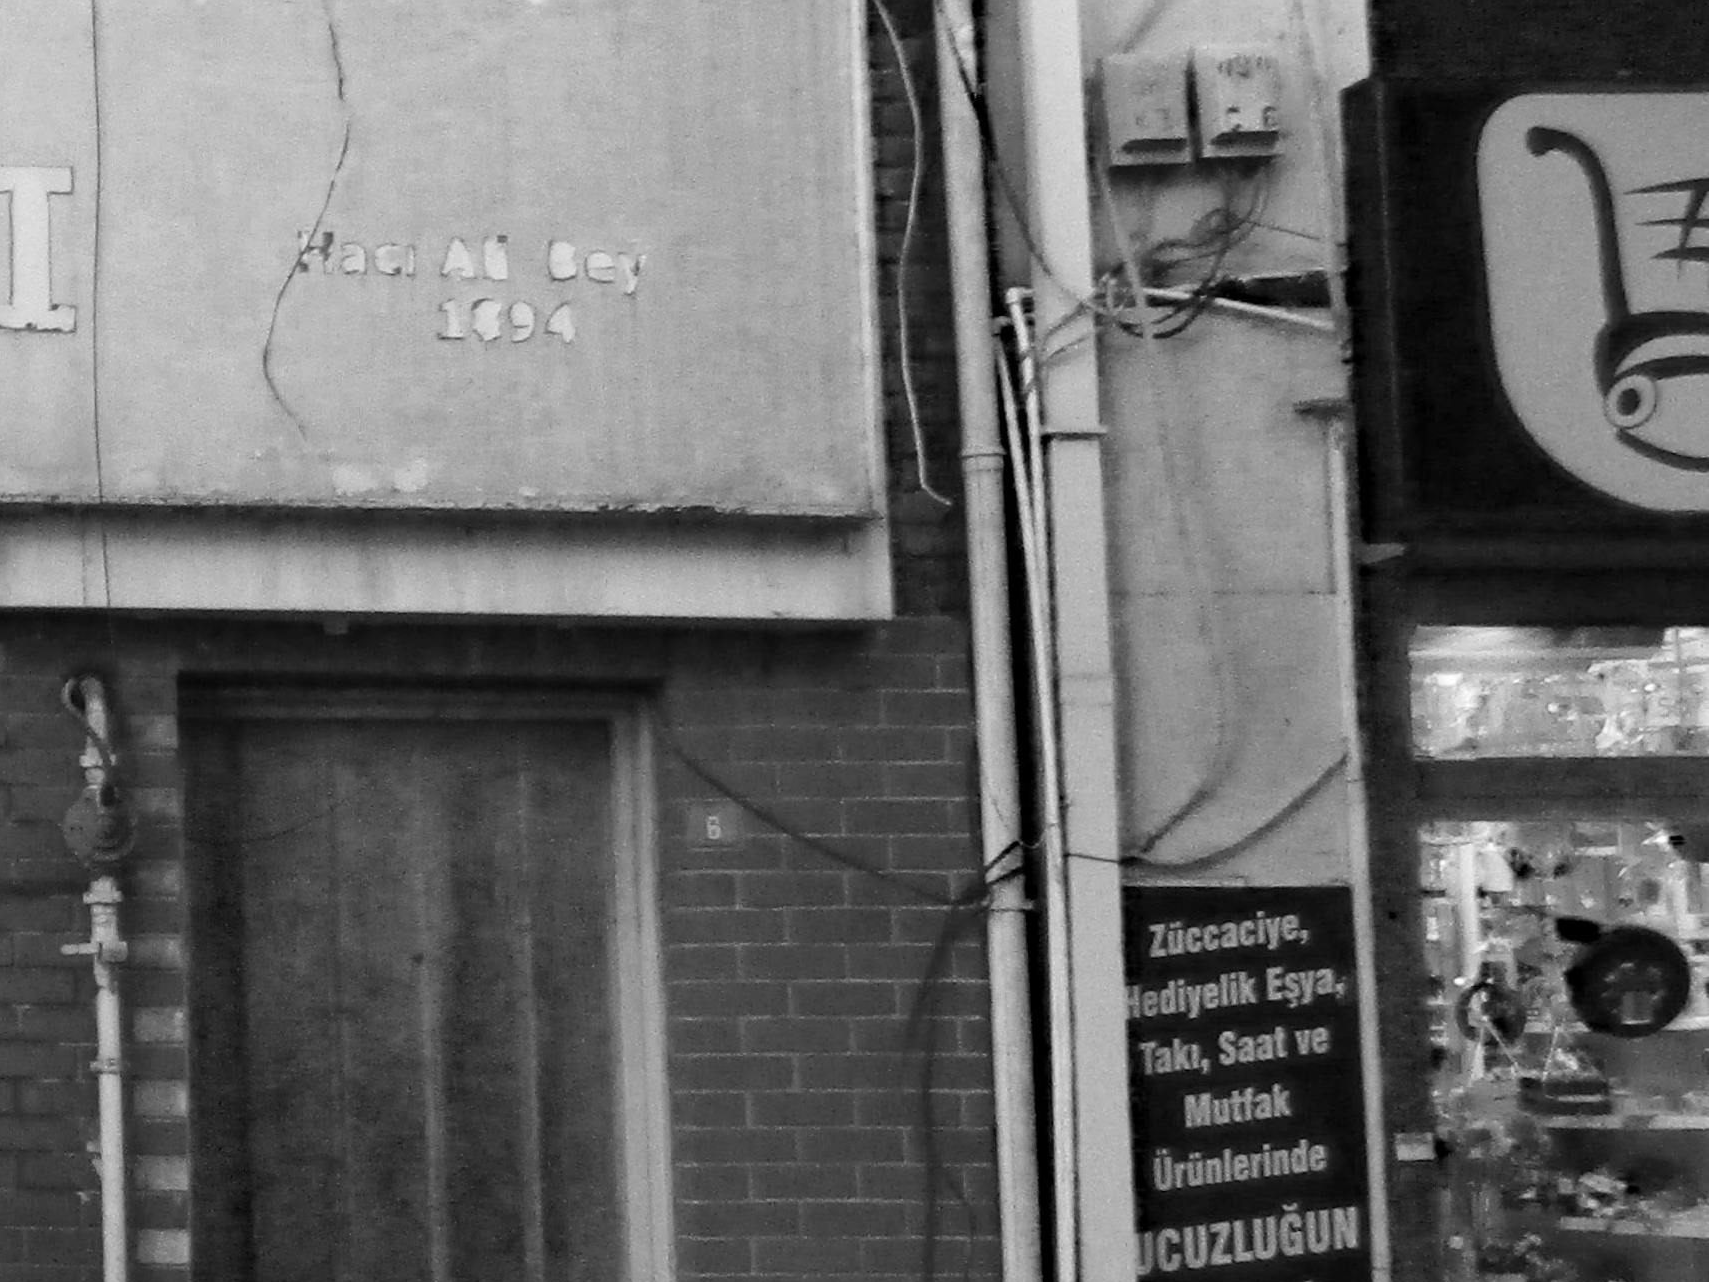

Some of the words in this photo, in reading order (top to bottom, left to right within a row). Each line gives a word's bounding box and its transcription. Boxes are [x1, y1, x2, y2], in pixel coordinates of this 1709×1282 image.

[548, 238, 647, 296] Bey
[1148, 910, 1310, 958] Züccaciye,
[1124, 970, 1259, 1019] Hediyelik
[1265, 965, 1347, 1009] Eşya,
[1138, 1037, 1211, 1076] Takı,
[1217, 1025, 1288, 1066] Saat
[1293, 1026, 1331, 1056] ve
[1183, 1082, 1293, 1129] Mutfak
[1152, 1137, 1329, 1192] Ürünlerinde
[1134, 1202, 1359, 1276] UCUZLUĞUN
